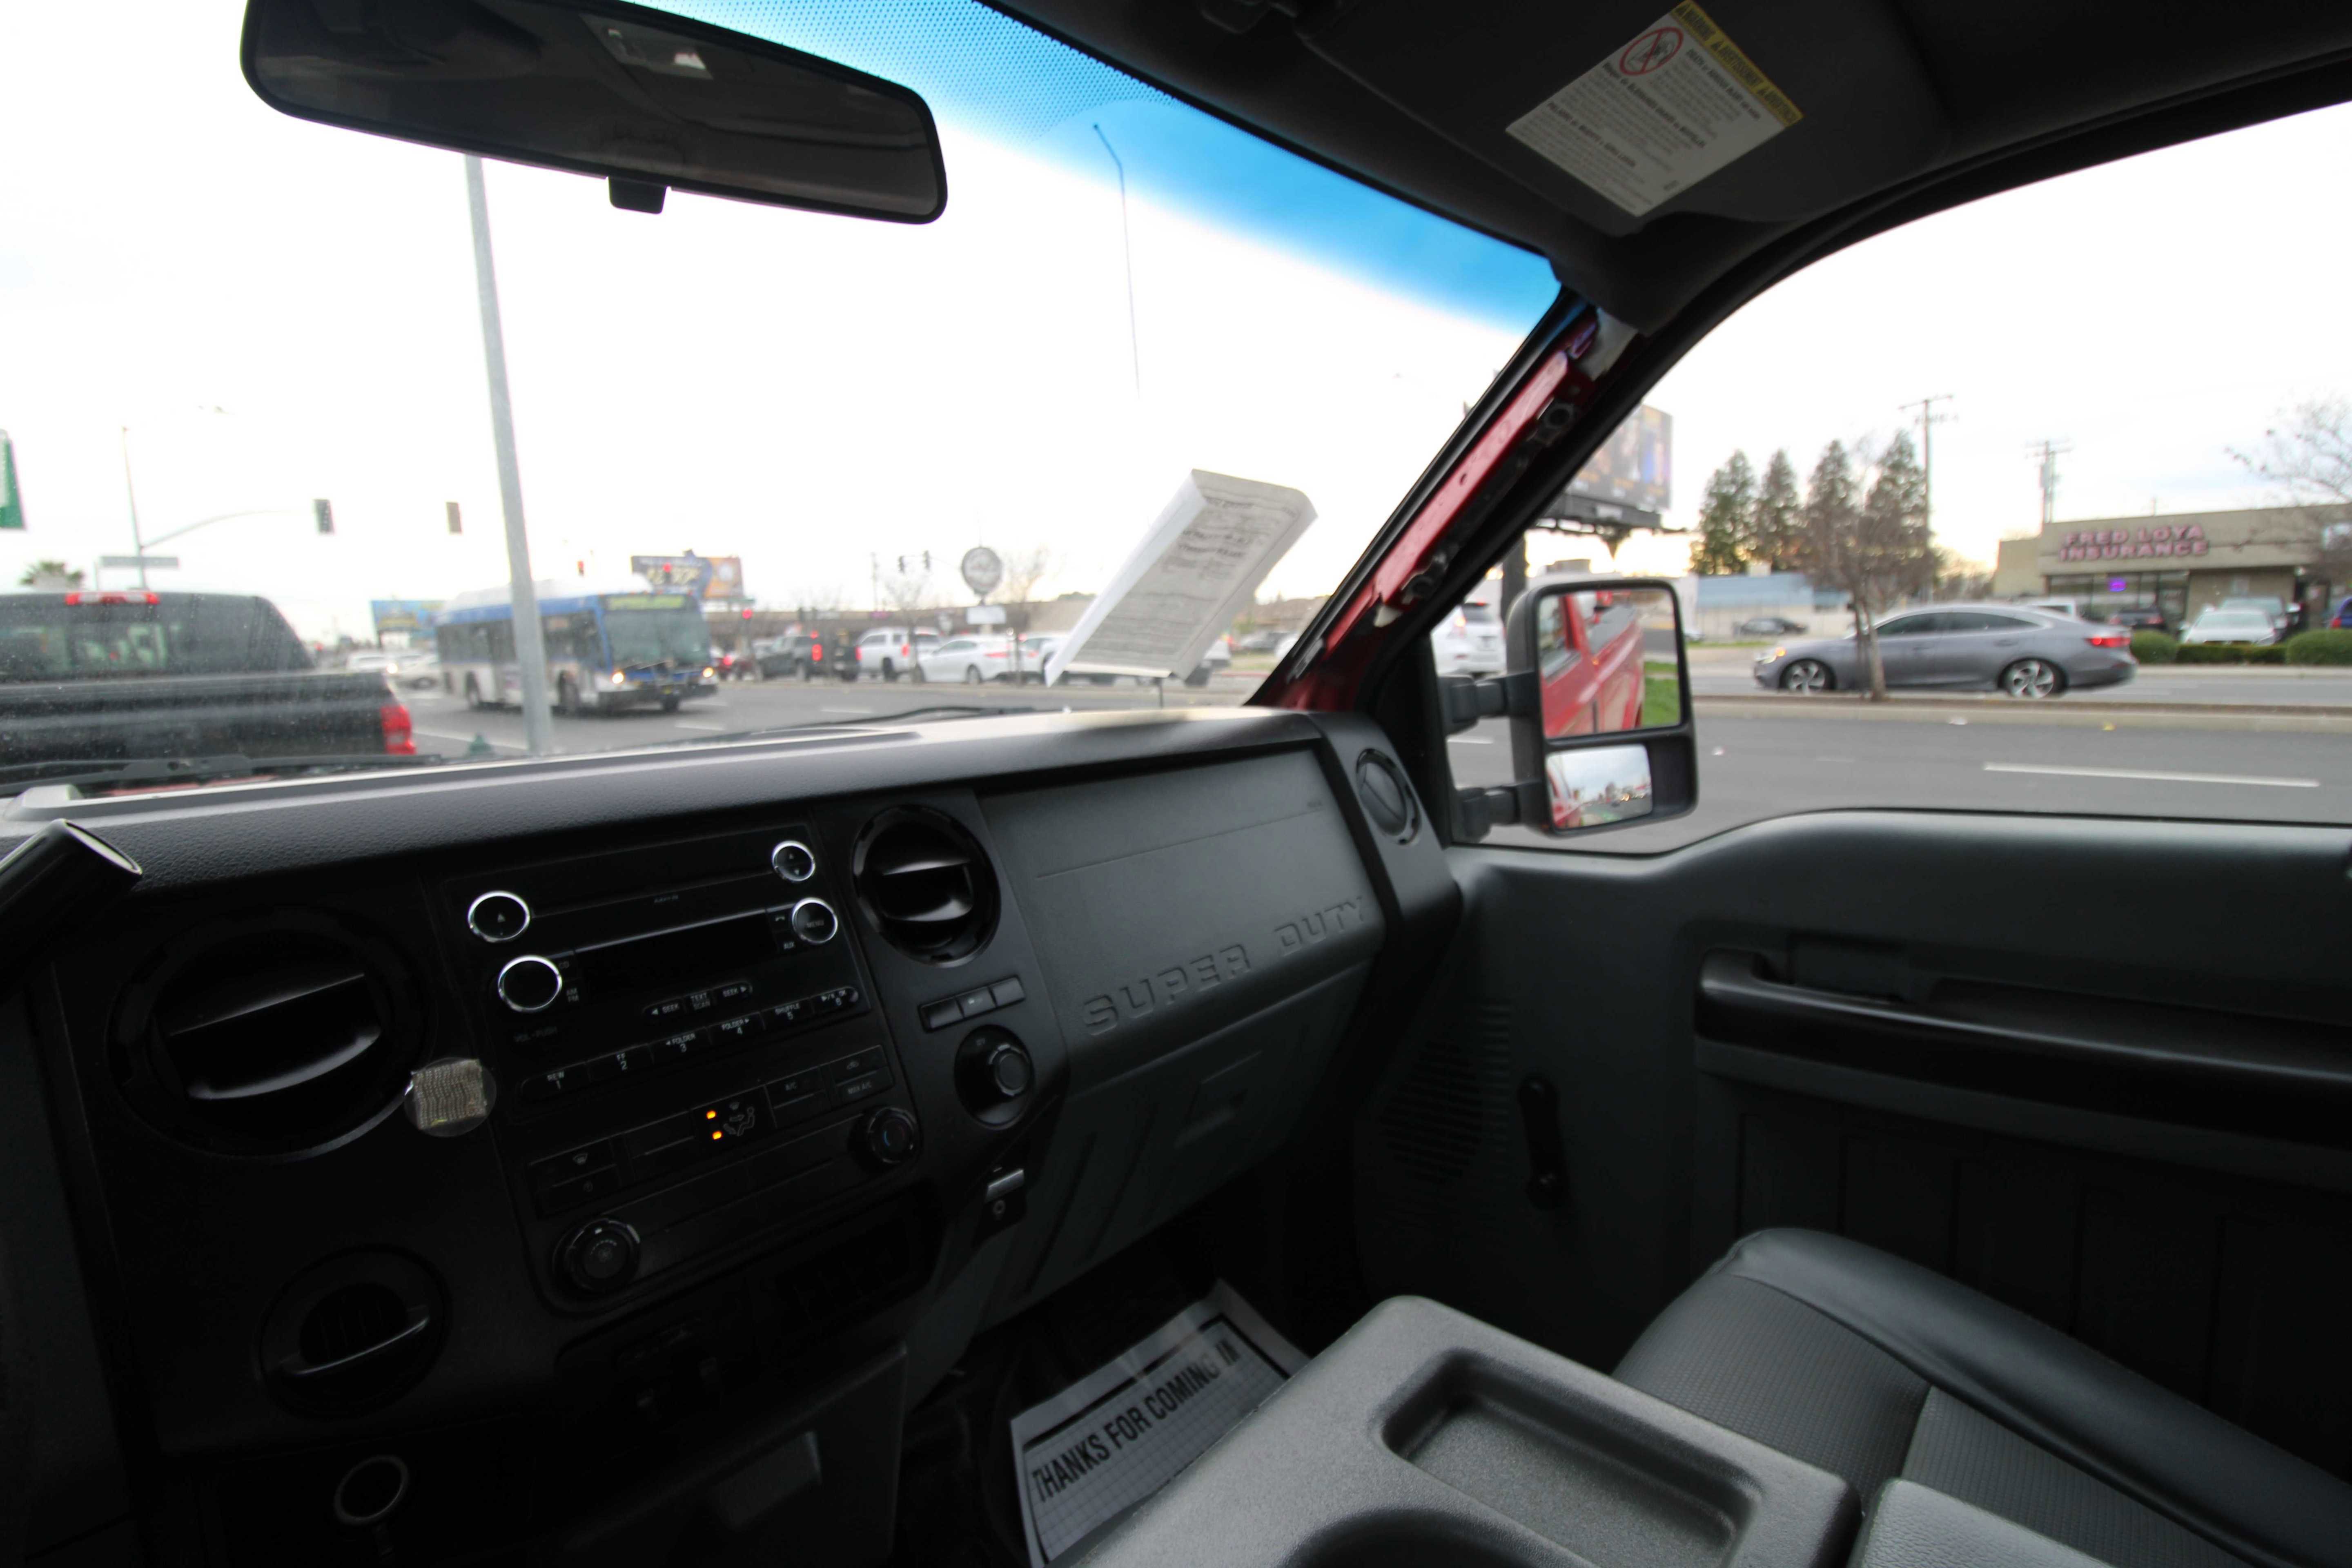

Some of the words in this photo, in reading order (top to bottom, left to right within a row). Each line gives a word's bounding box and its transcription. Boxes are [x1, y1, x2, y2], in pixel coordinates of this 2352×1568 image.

[2065, 530, 2128, 546] FRED
[2137, 525, 2203, 542] LOYA
[2060, 541, 2209, 561] INSURANCE
[1082, 944, 1252, 1036] SUPER
[1273, 896, 1365, 957] DUTY
[690, 993, 707, 1001] TEXT
[722, 987, 739, 998] SEEK
[662, 1003, 680, 1014] SEEK
[722, 1019, 744, 1031] FOLDER
[737, 1027, 744, 1035] 4
[672, 1033, 696, 1045] FOLDER
[680, 1043, 687, 1053] 3
[620, 1060, 628, 1071] 2
[1032, 1434, 1110, 1502] THANKS
[1104, 1406, 1153, 1450] FOR
[1144, 1352, 1221, 1420] COMING
[1215, 1340, 1241, 1366] IN
